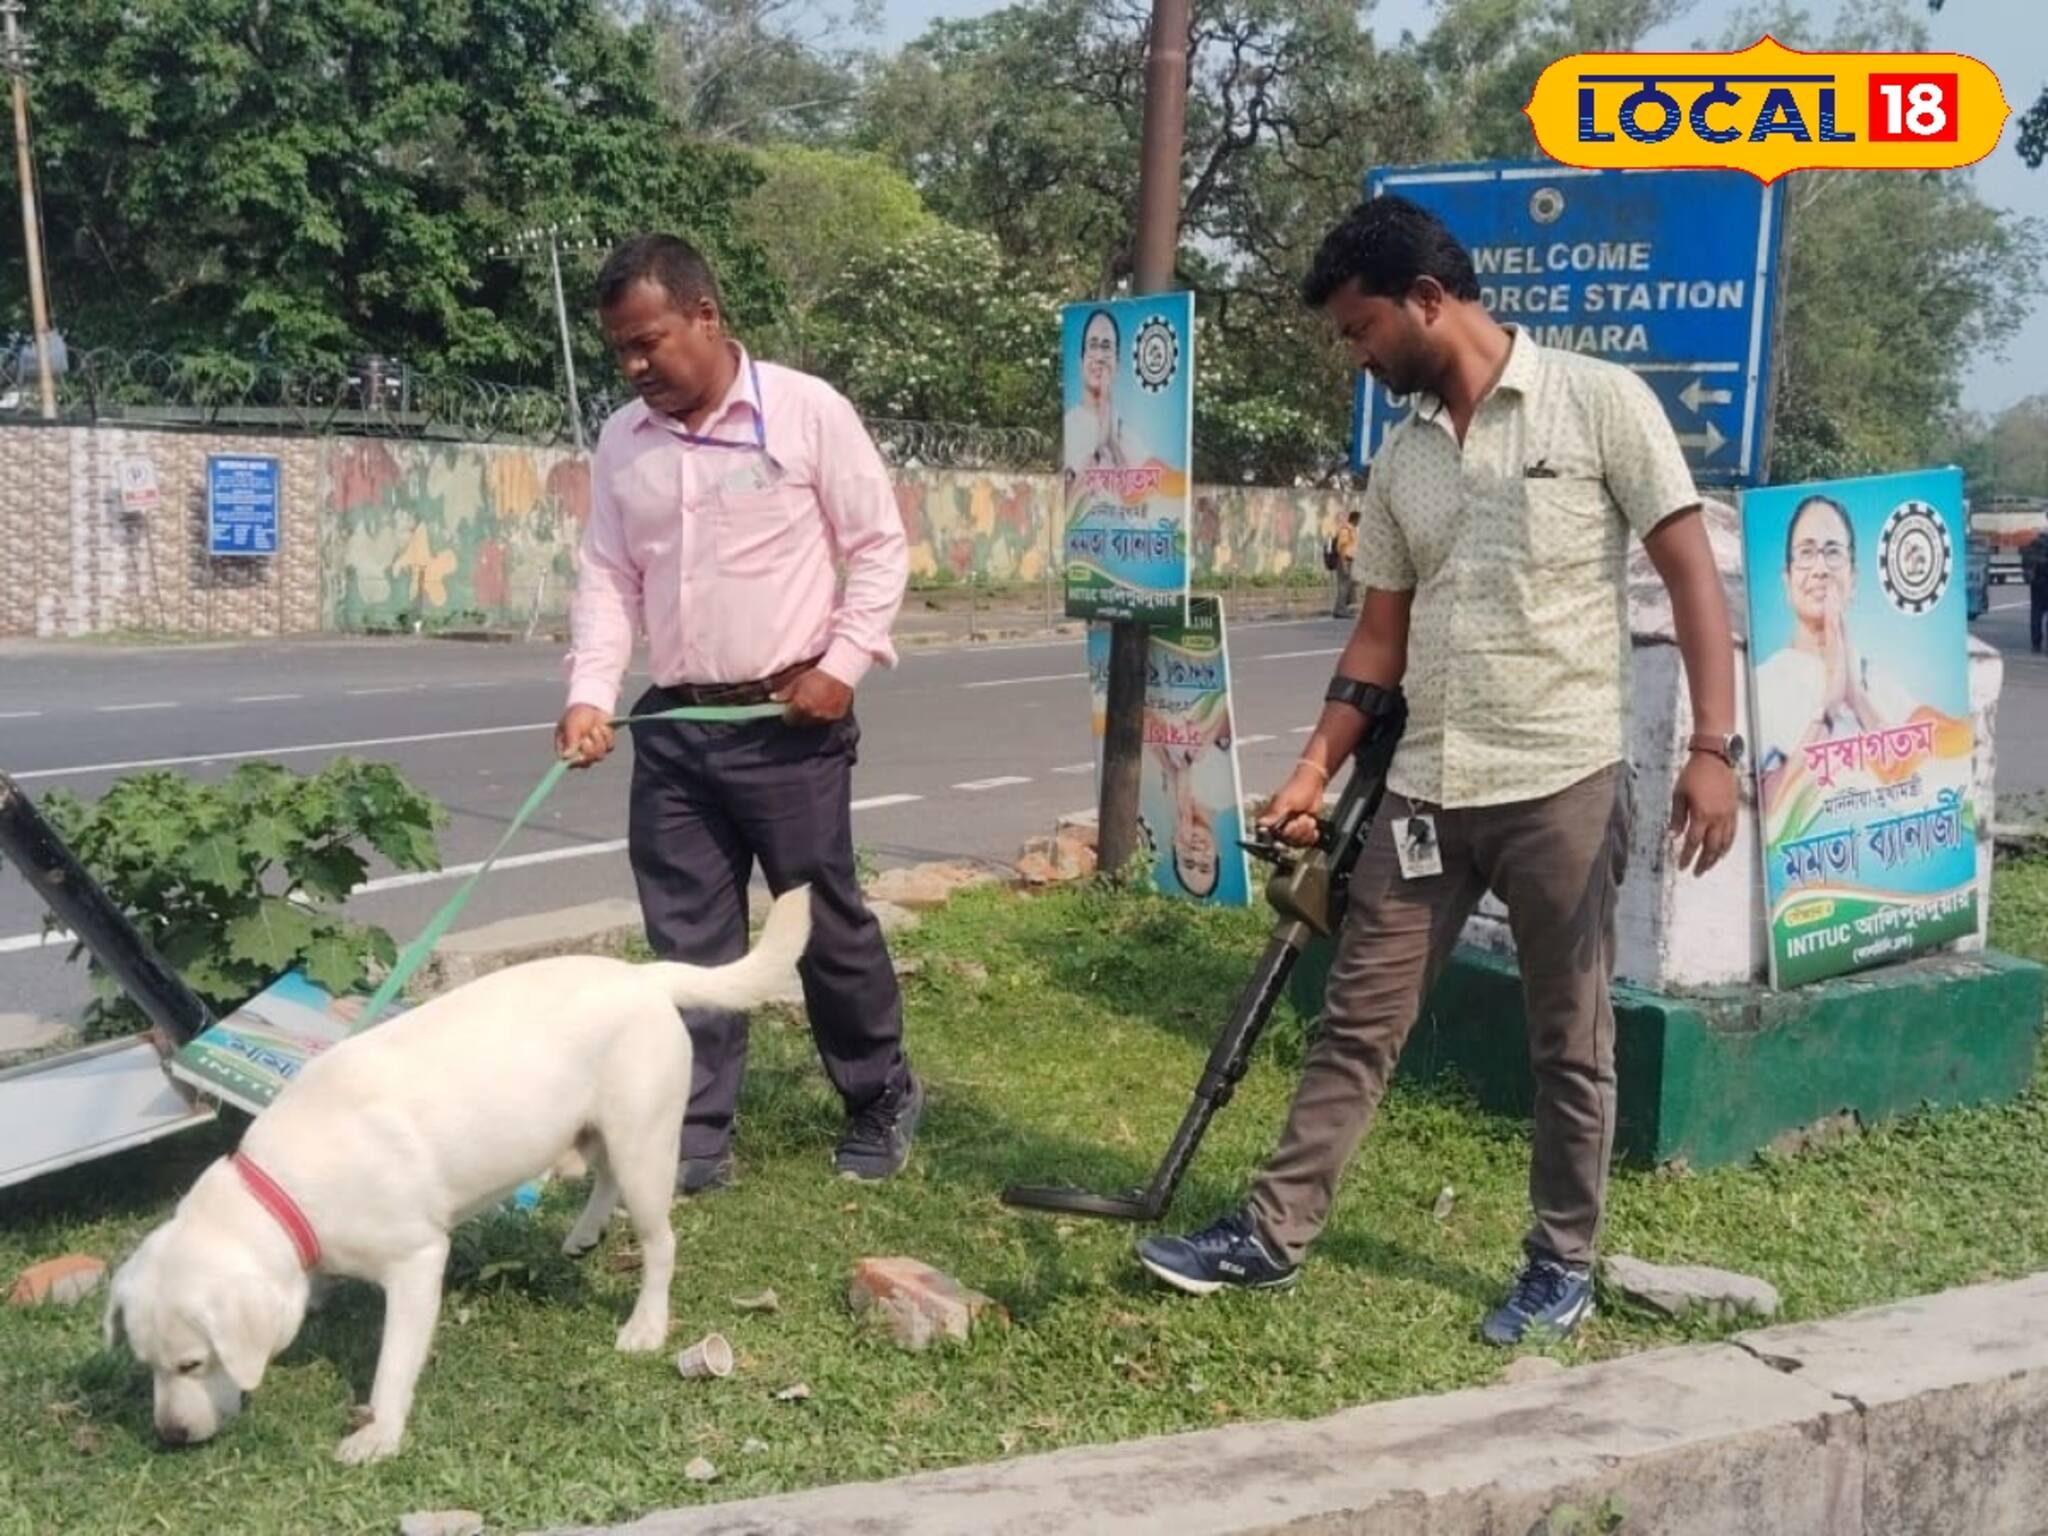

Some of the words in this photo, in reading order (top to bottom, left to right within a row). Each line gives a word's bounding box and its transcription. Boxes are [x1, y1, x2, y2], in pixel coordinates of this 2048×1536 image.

[1472, 242, 1652, 275] WELCOME
[1480, 284, 1570, 313] ORCE
[1583, 280, 1744, 313] STATION
[1780, 826, 1860, 884] মমতা
[1786, 922, 1851, 959] INTTUC
